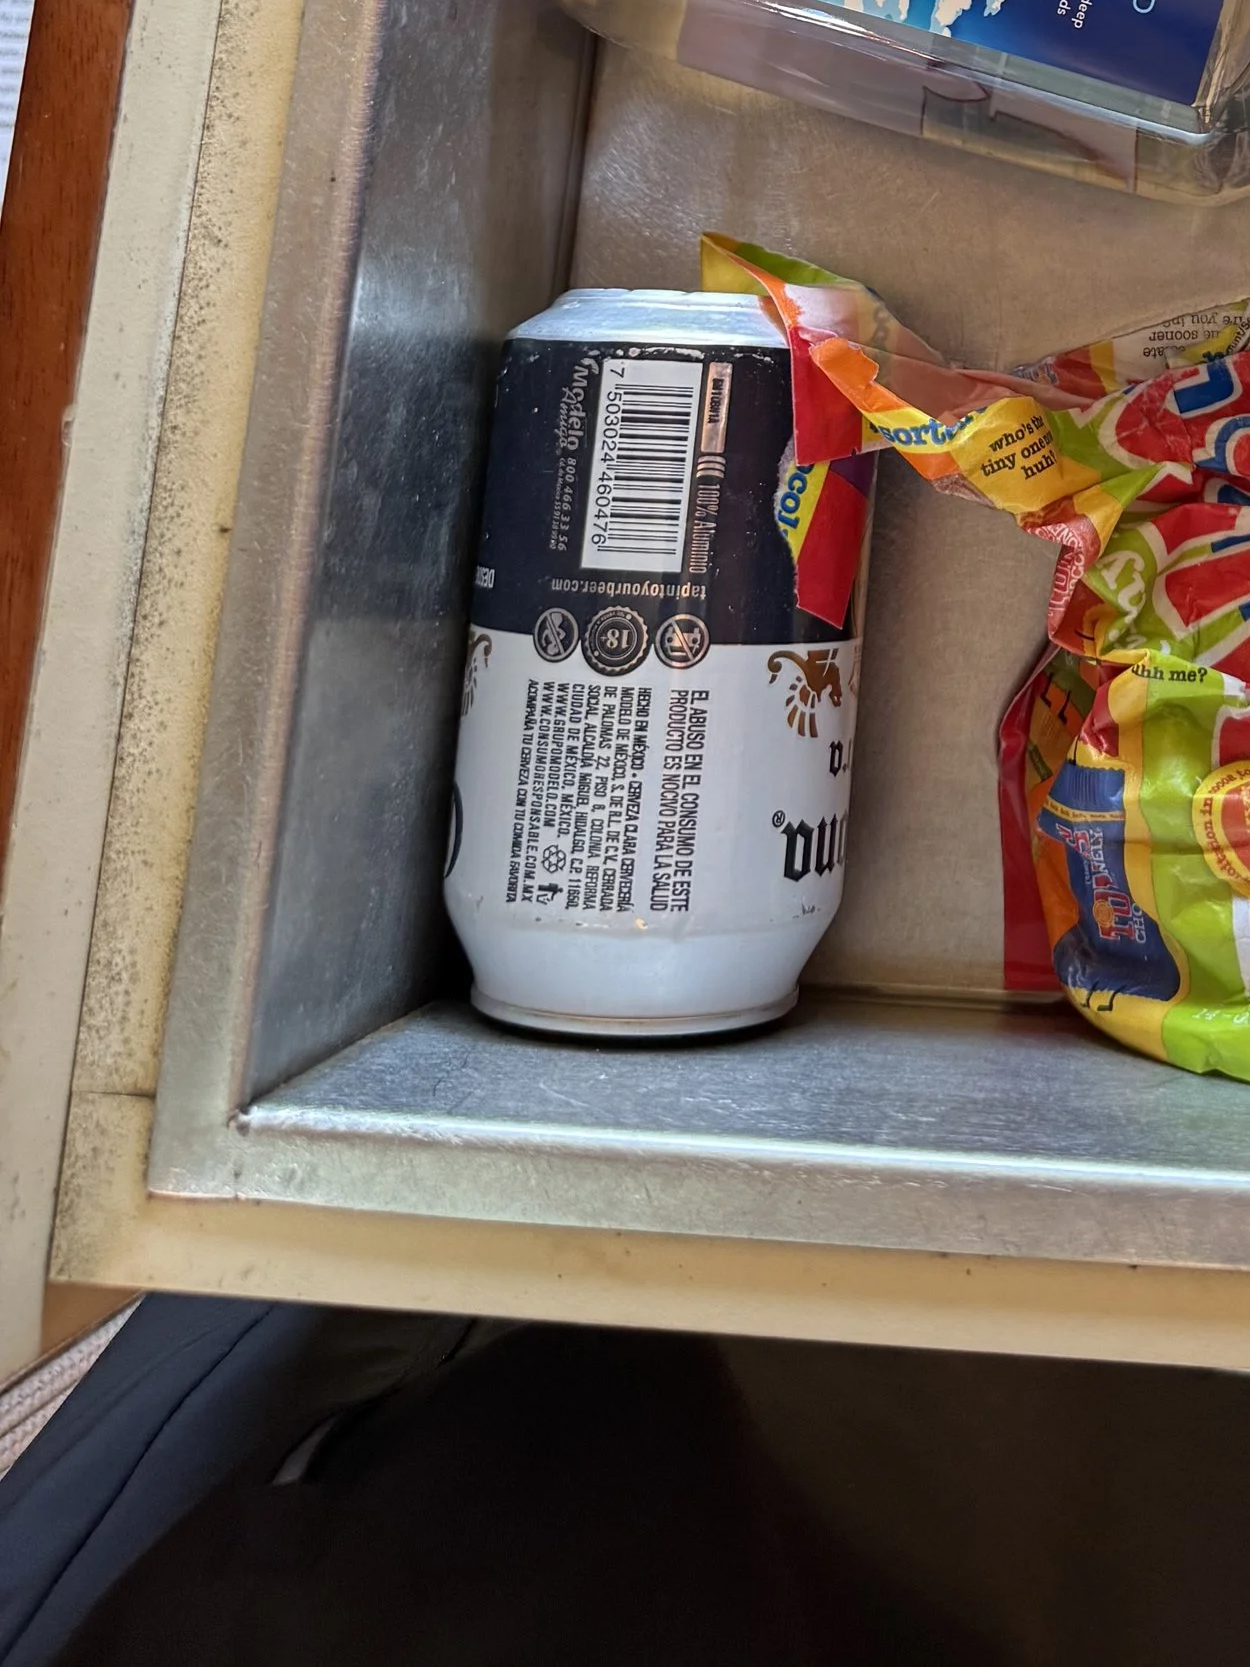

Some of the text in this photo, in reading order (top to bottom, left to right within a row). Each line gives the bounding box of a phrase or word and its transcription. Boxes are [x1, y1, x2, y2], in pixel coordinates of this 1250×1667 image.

[1146, 330, 1200, 341] sooner
[1189, 312, 1220, 324] you
[565, 364, 588, 449] Modelo
[600, 390, 622, 462] 503024
[979, 450, 1018, 479] tiny
[558, 457, 575, 550] 800 466 33 56
[591, 470, 610, 543] 460476
[688, 484, 719, 573] 100% Aluminio
[551, 579, 706, 600] tapintoyourbeer.com
[1168, 667, 1207, 682] me?
[542, 681, 569, 827] WWW.GRUPOMODELO.COM
[650, 689, 689, 911] PRODUCTO ES NOCIVO PARA LA SALUD
[670, 690, 709, 911] EL ABUSO EN EL CONSUMO DE ESTE
